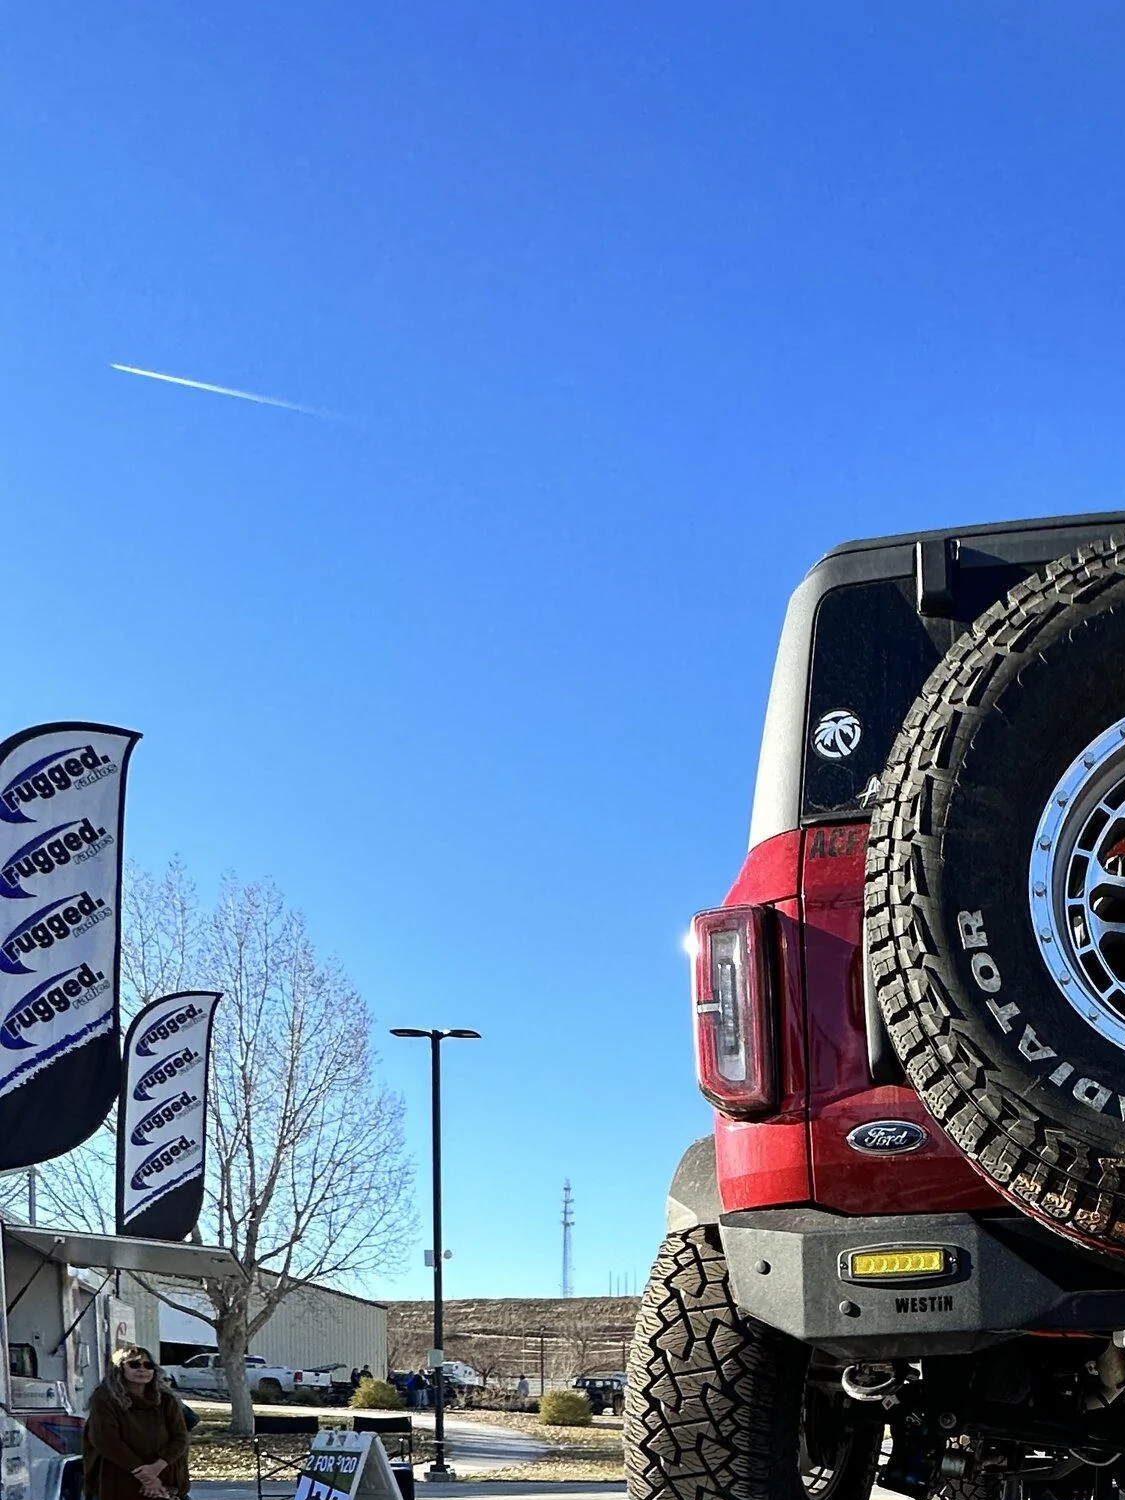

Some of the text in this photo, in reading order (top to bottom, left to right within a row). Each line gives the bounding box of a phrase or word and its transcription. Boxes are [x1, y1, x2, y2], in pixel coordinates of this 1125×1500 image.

[864, 1127, 908, 1146] Ford
[305, 1454, 358, 1473] 2 FOR $120
